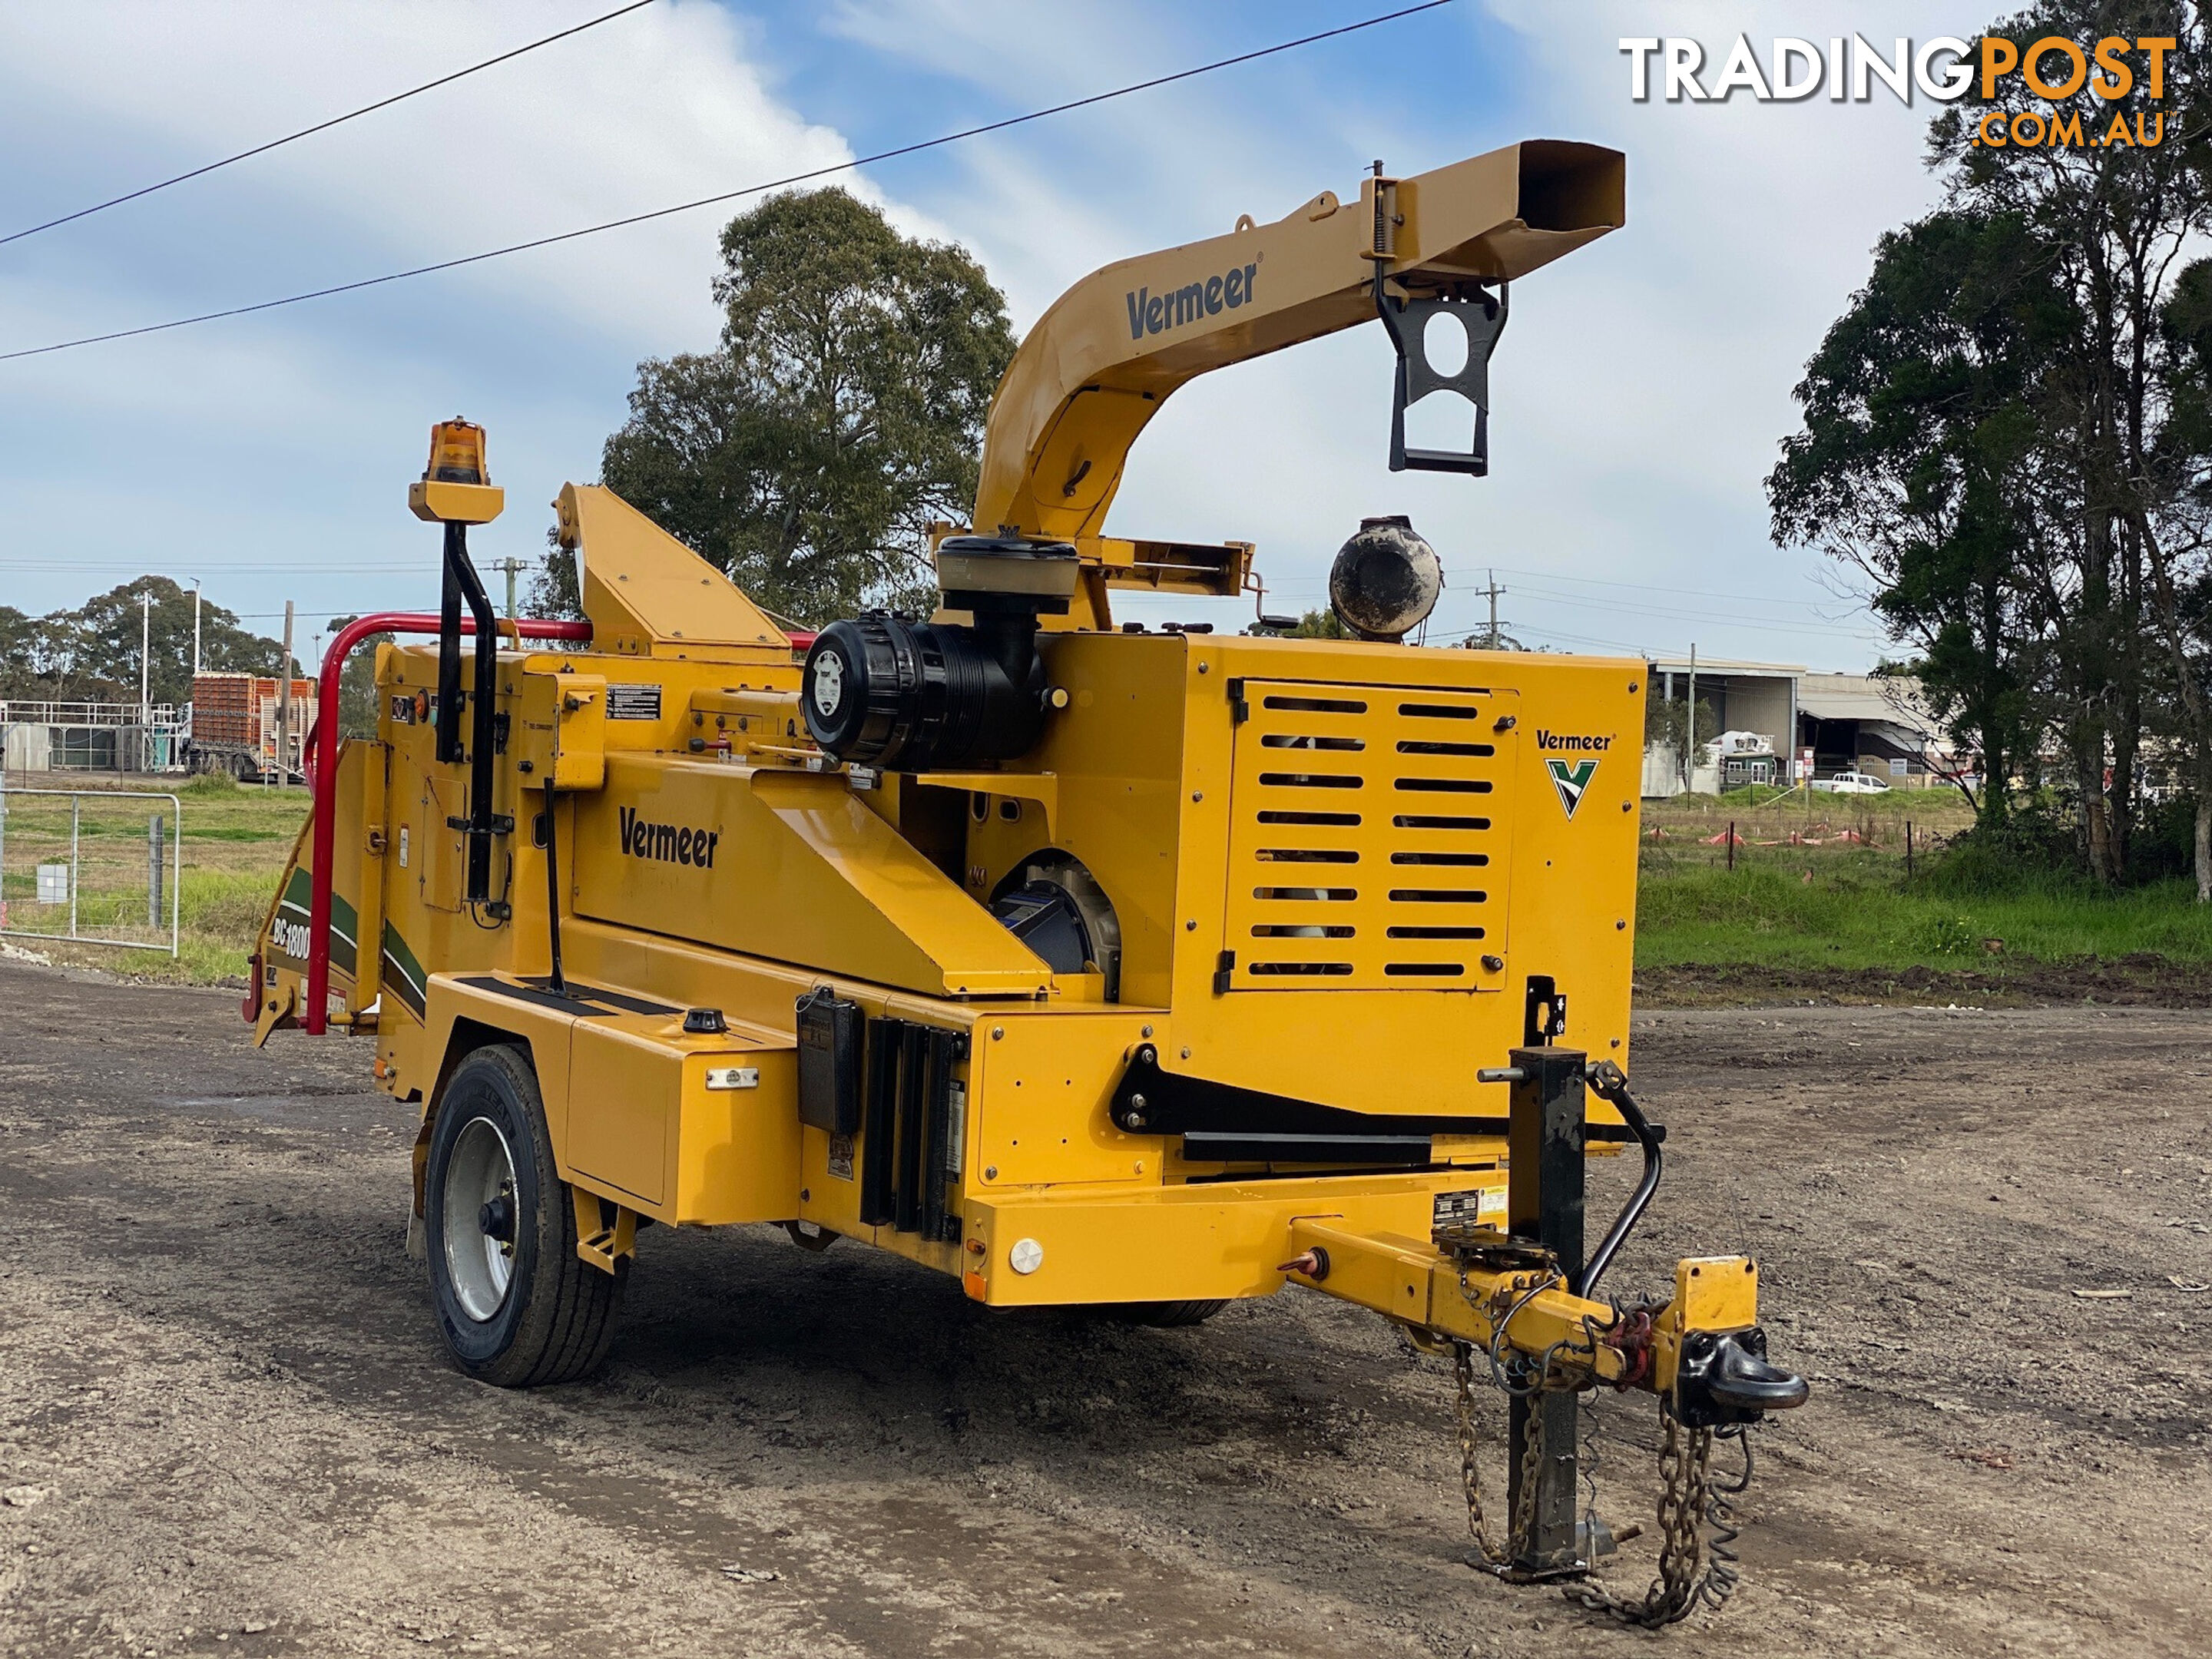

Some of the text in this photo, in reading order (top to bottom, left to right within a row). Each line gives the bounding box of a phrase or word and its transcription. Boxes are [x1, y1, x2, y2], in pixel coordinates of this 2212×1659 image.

[1126, 261, 1258, 341] Vermeer
[1536, 729, 1611, 751] Vermeer
[619, 805, 718, 869] Vermeer
